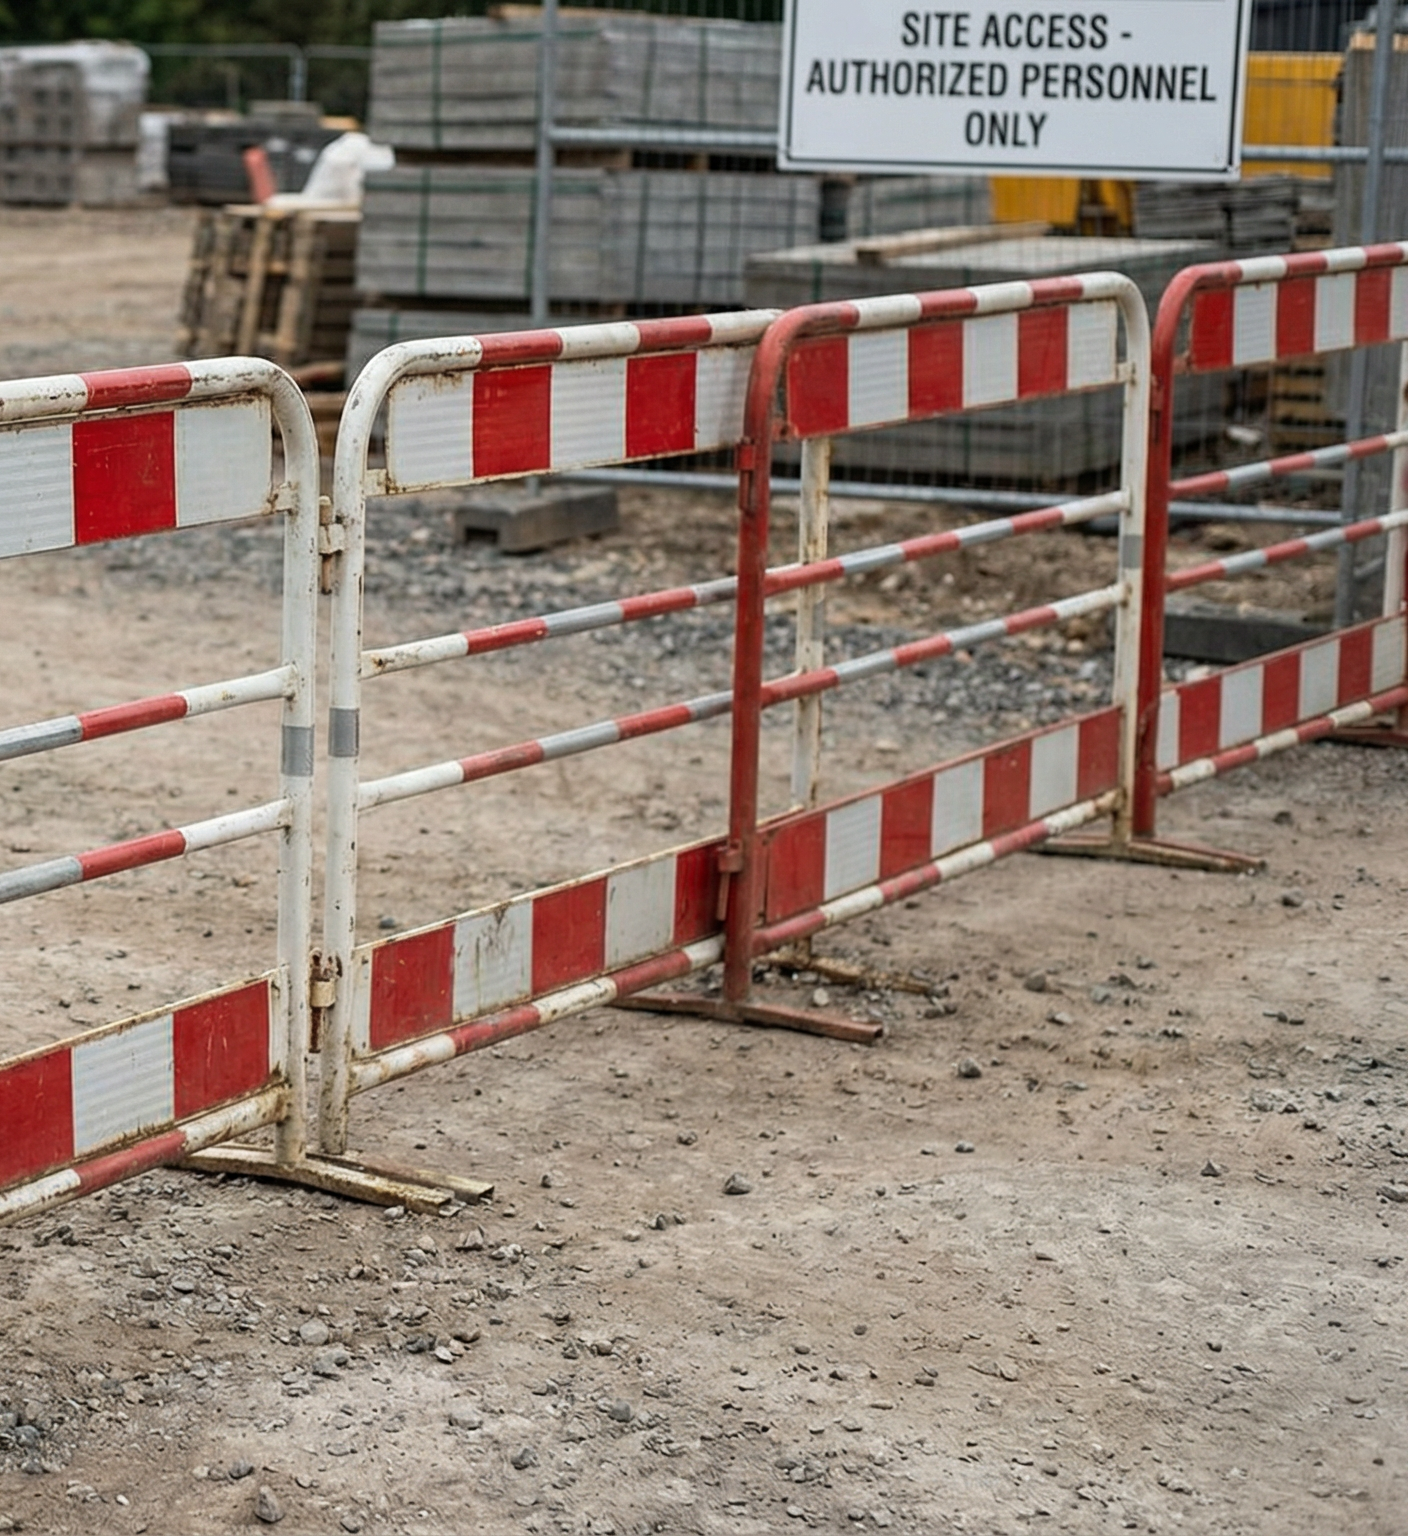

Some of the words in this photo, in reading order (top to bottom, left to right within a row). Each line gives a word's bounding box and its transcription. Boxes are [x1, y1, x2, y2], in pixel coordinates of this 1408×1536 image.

[902, 12, 969, 47] SITE
[981, 13, 1108, 50] ACCESS
[806, 60, 1008, 97] AUTHORIZED
[1021, 63, 1216, 102] PERSONNEL
[965, 111, 1047, 147] ONLY
